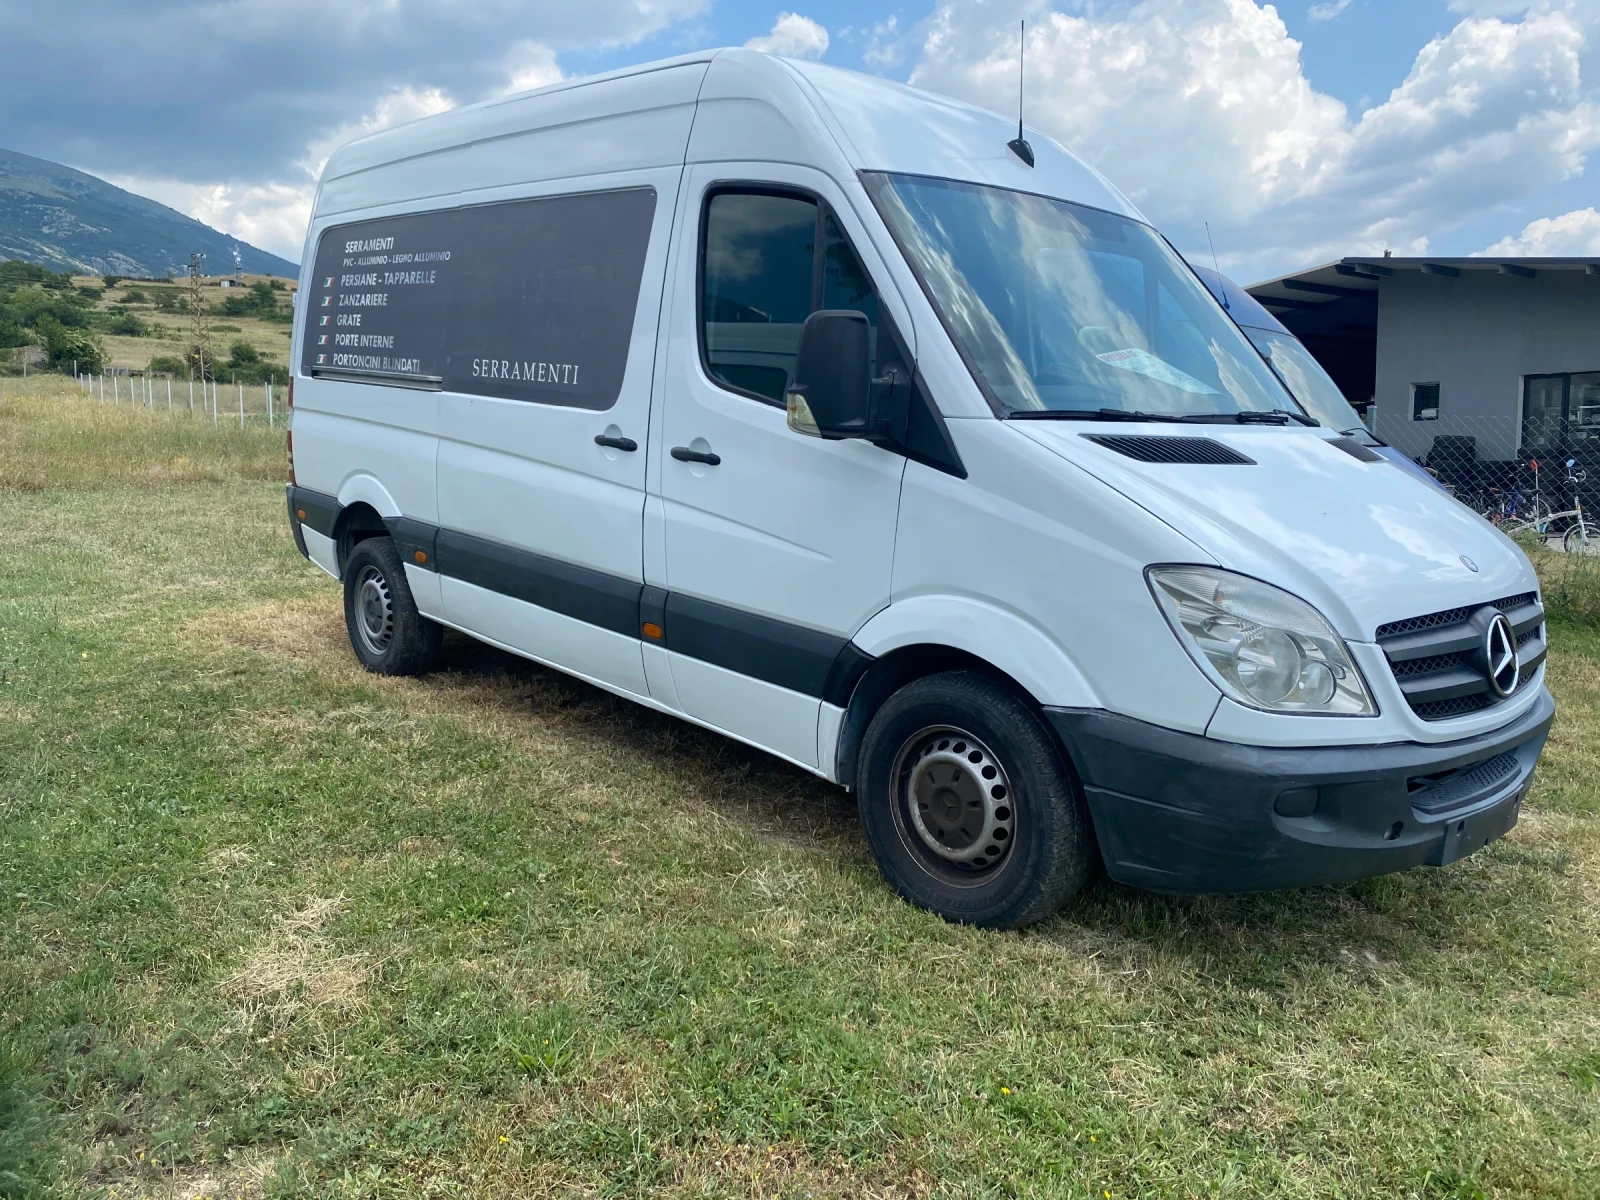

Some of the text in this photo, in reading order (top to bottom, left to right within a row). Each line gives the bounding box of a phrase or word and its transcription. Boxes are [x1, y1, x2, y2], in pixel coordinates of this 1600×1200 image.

[345, 237, 394, 253] SERRAMENTI
[343, 258, 354, 267] PVC
[358, 255, 388, 266] ALLUMINIO
[392, 253, 412, 264] LEGNO
[414, 251, 451, 262] ALLUMINIO
[340, 273, 377, 286] PERSIANE
[384, 270, 436, 285] TAPPARELLE
[338, 294, 388, 306] ZANZARIERE
[336, 314, 362, 326] GRATE
[335, 334, 394, 348] PORTE INTERNE
[333, 354, 420, 372] PORTONCINI BLINDATI
[472, 358, 580, 384] SERRAMENTI
